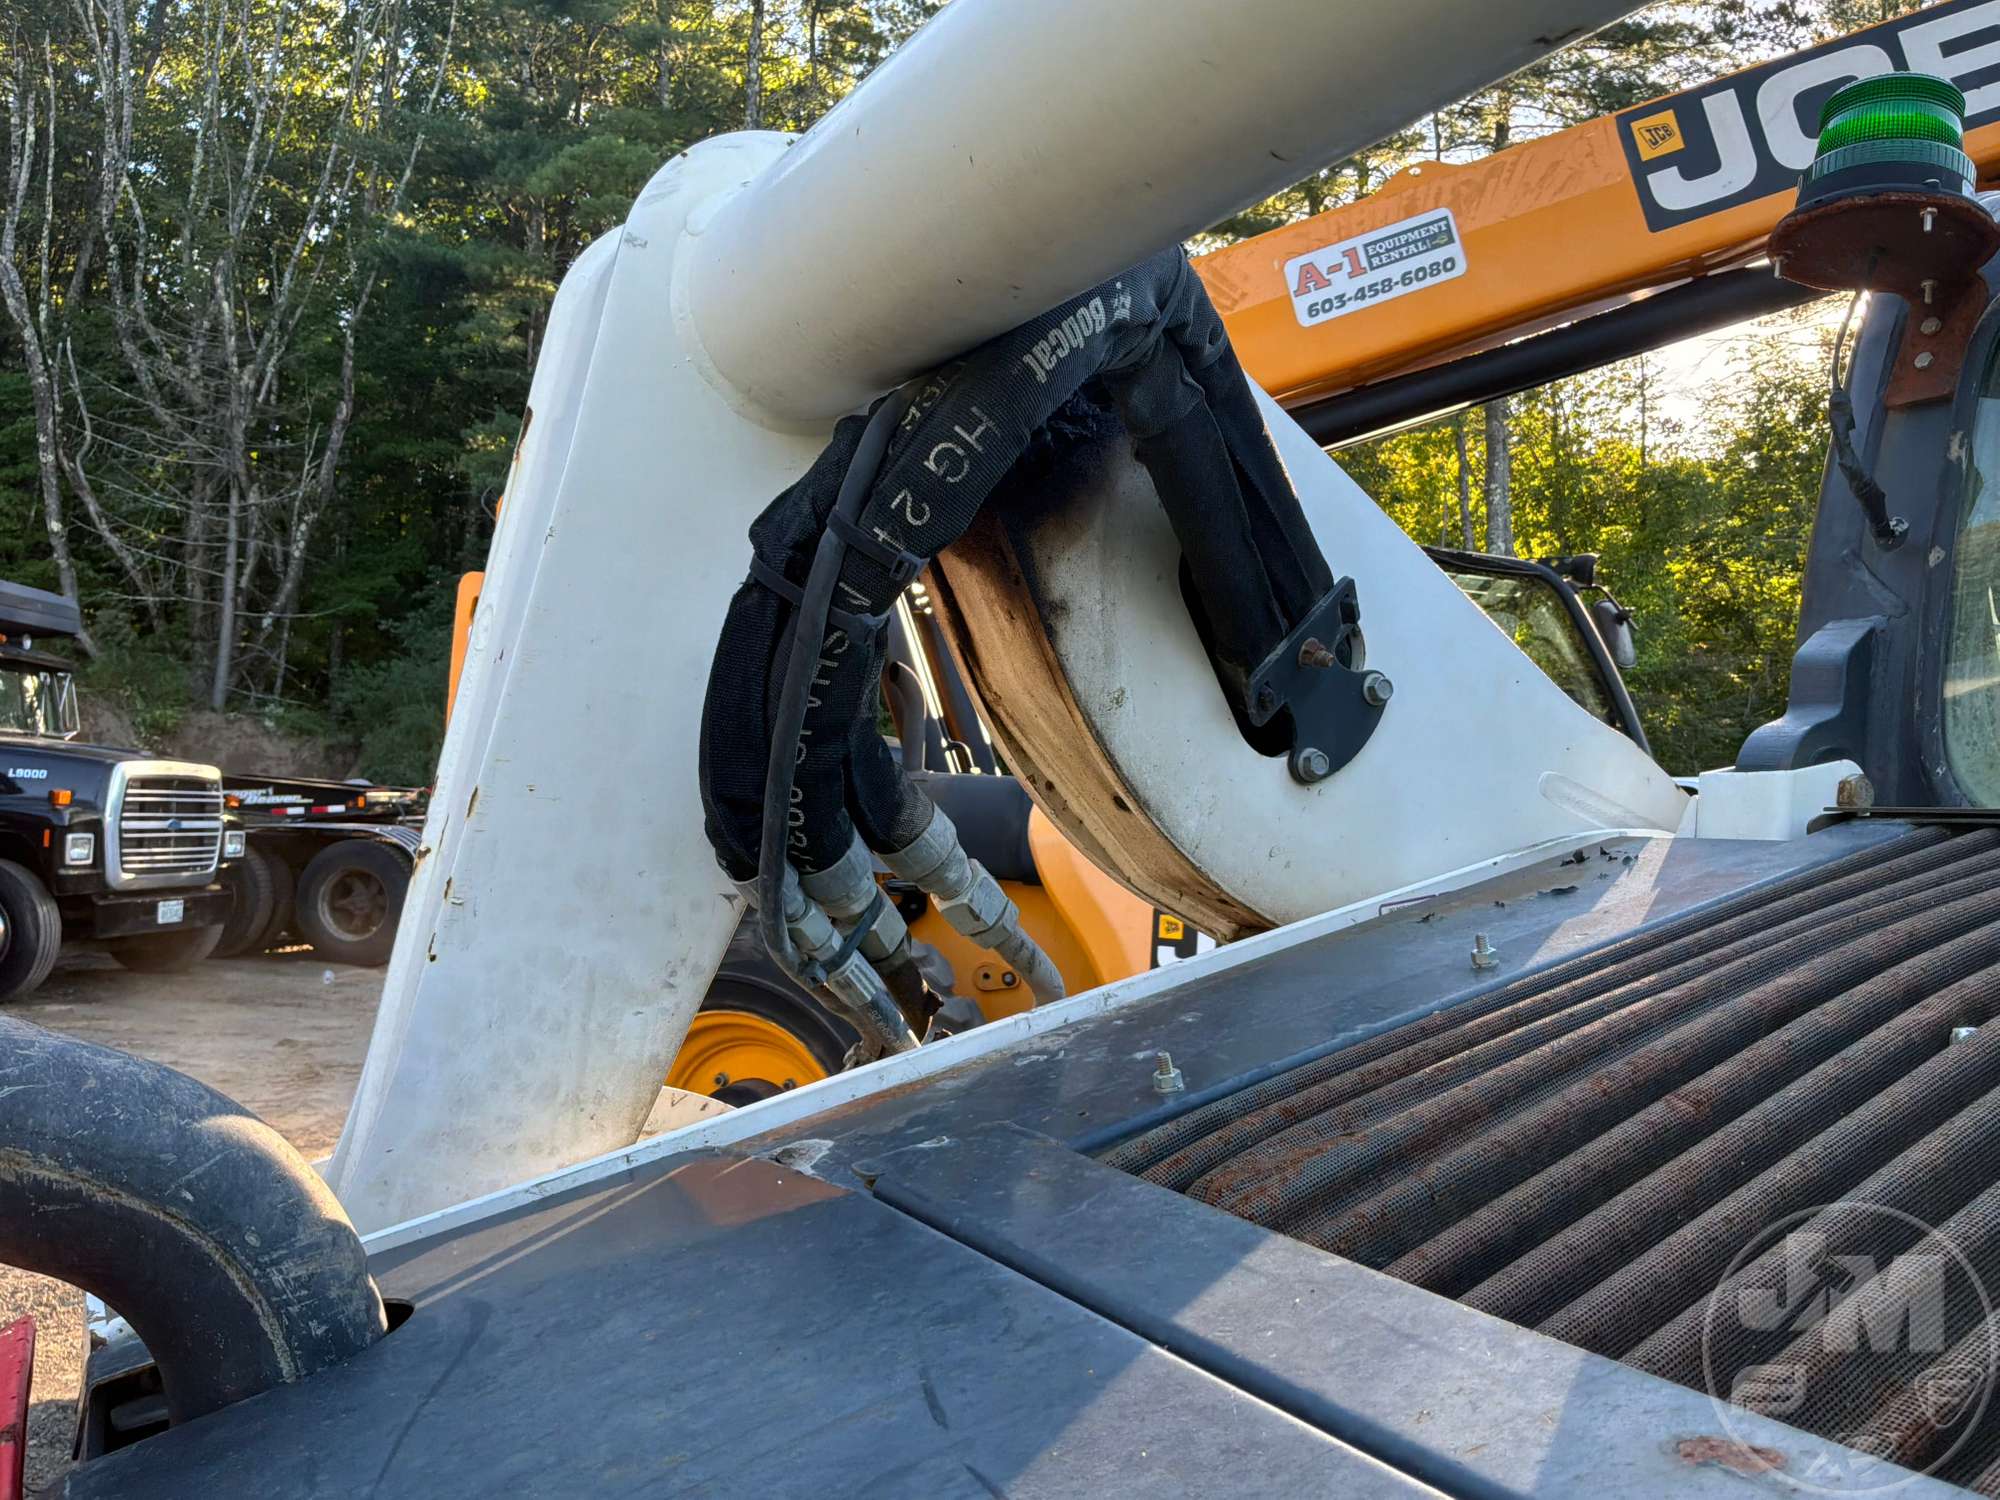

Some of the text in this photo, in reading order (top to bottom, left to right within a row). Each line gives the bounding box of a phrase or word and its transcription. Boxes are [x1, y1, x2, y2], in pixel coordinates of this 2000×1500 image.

[1293, 220, 1449, 297] A-1 EQUIPMENT
[1307, 256, 1456, 318] 603-458-6080
[1371, 240, 1427, 268] RENTAL
[1023, 296, 1106, 383] Bobcat
